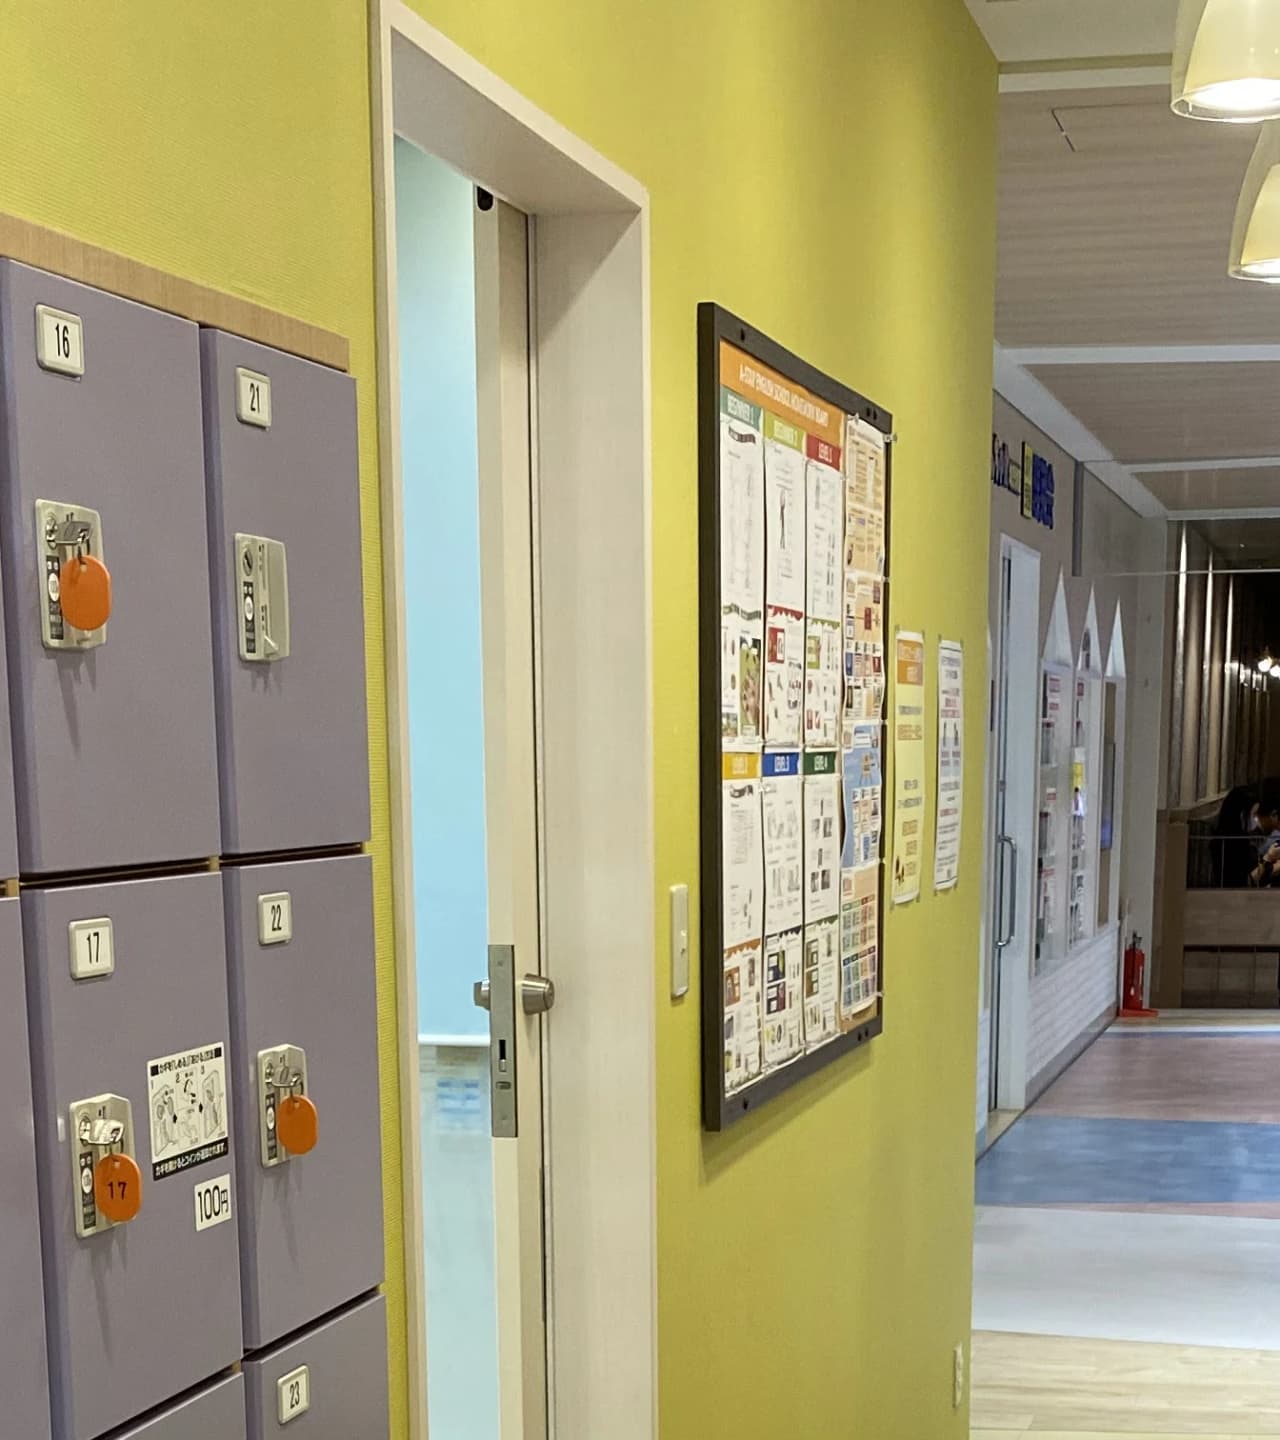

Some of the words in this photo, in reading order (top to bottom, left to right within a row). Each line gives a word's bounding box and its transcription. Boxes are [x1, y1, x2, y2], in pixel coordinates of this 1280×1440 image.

[55, 323, 70, 359] 16
[249, 382, 260, 412] 21
[270, 904, 282, 932] 22
[86, 931, 100, 964] 17
[107, 1181, 127, 1200] 17
[197, 1185, 229, 1222] 100円
[289, 1380, 300, 1410] 23
